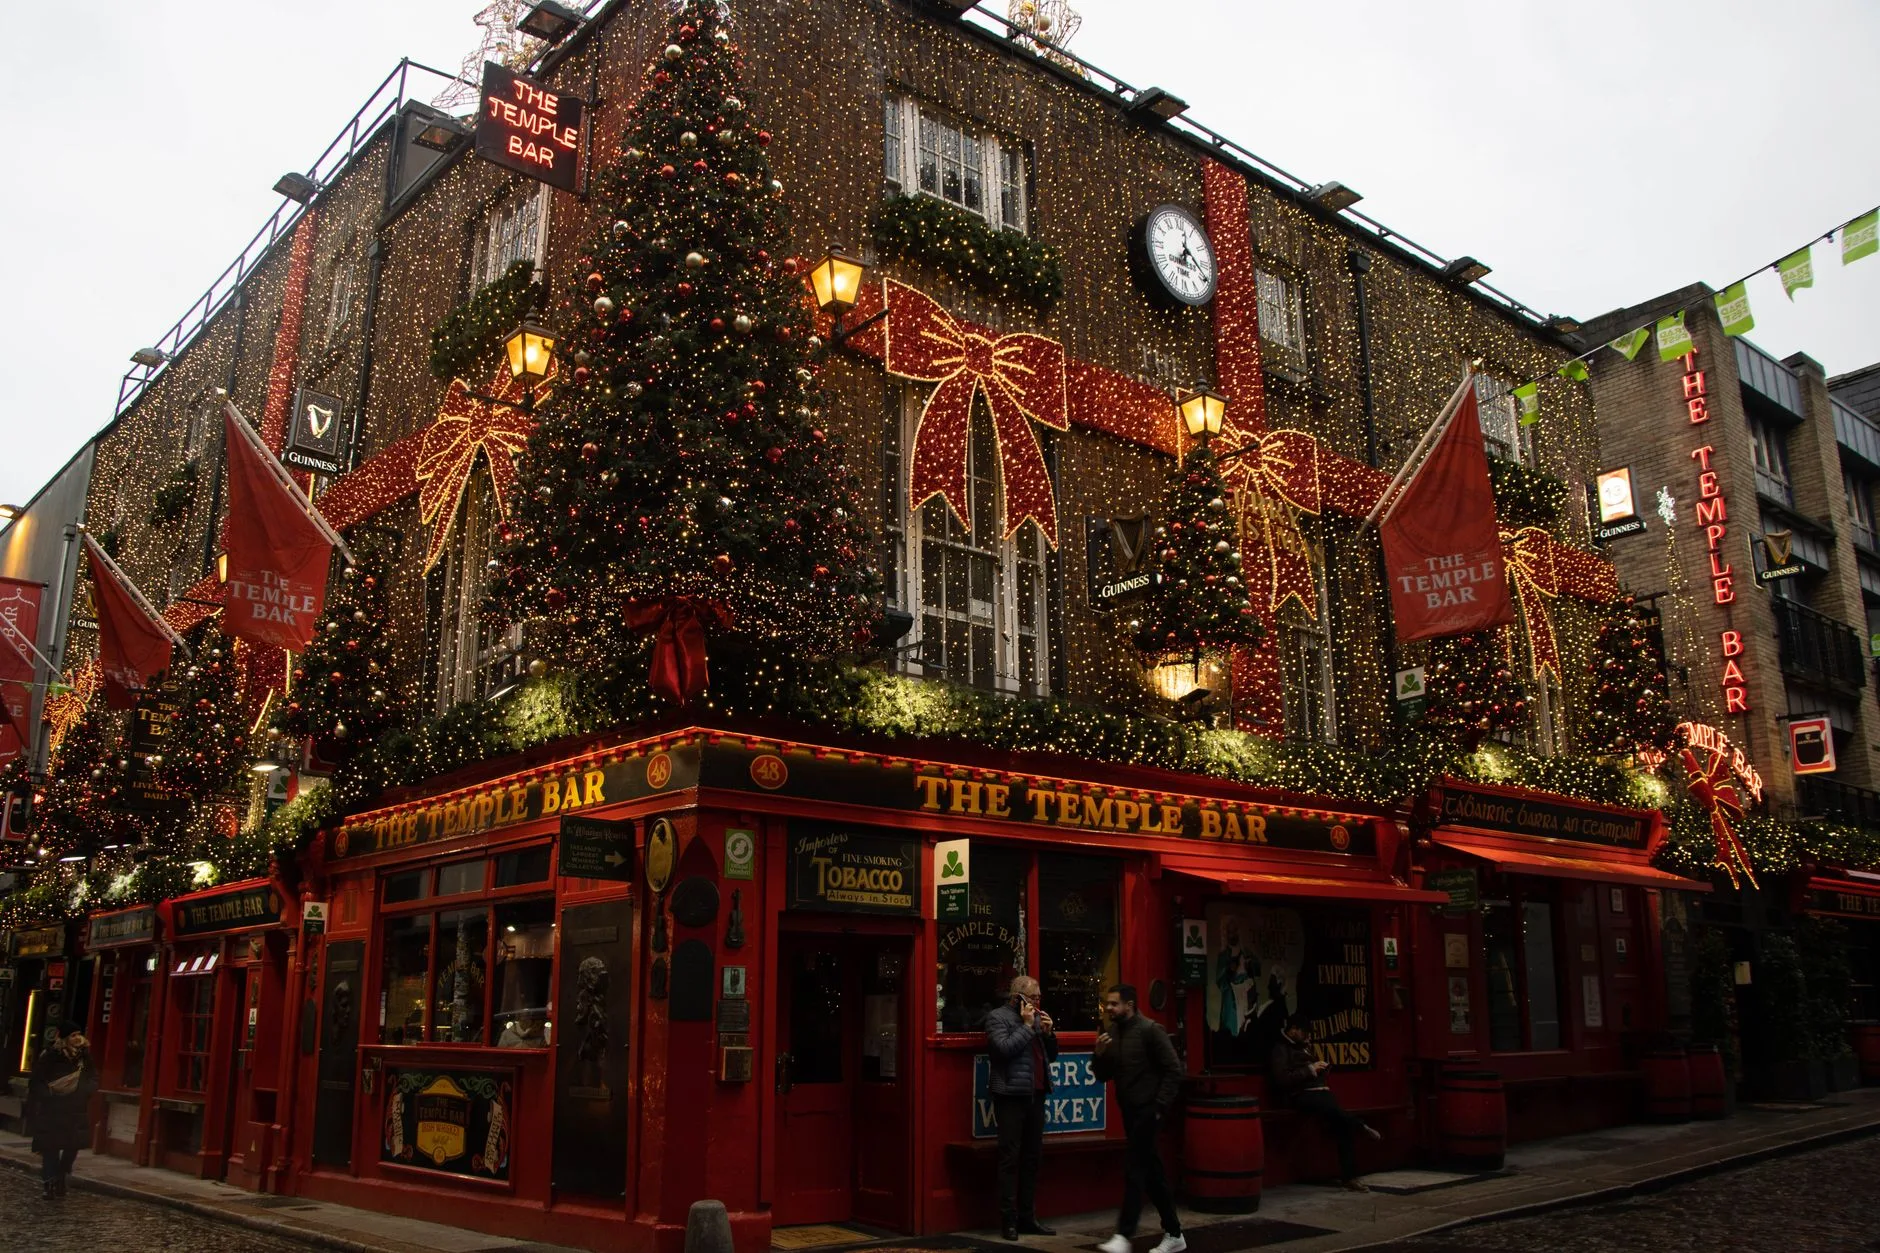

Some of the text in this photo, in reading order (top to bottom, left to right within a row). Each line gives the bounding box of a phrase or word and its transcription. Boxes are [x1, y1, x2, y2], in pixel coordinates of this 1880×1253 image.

[513, 79, 559, 115] THE
[488, 96, 578, 149] TEMPLE
[508, 135, 554, 169] BAR
[1177, 266, 1190, 279] TIME
[288, 451, 338, 473] GUINNESS
[1600, 521, 1640, 538] GUINNESS
[1677, 347, 1751, 714] THE TEMPLE BAR
[1425, 554, 1465, 572] THE
[1761, 565, 1801, 581] GUINNESS
[1101, 573, 1150, 598] GUINNESS
[1397, 561, 1496, 594] TEMPLE
[1426, 587, 1478, 609] BAR
[77, 619, 100, 630] GUIN
[252, 602, 296, 626] BAR
[138, 708, 172, 723] TEM
[149, 723, 171, 737] BA
[650, 761, 667, 783] 48
[756, 761, 780, 782] 48
[1674, 721, 1763, 802] MPLE BAR
[374, 769, 606, 849] THE TEMPLE BAR
[915, 775, 1269, 843] THE TEMPLE BAR
[1333, 829, 1346, 845] 48
[842, 853, 903, 867] FINE SMOKING
[811, 857, 904, 896] TOBACCO
[828, 891, 910, 905] Always in Stock
[1838, 893, 1863, 912] THE
[191, 896, 265, 927] THE TEMPLE BAR
[973, 904, 993, 916] THE
[939, 921, 995, 952] TEMPLE
[1343, 944, 1366, 965] THE
[1317, 964, 1367, 985] EMPEROR
[1354, 986, 1367, 1007] OF
[1327, 1007, 1370, 1036] LIQUORS
[1311, 1041, 1371, 1065] NNESS
[976, 1096, 1104, 1130] WSKEY
